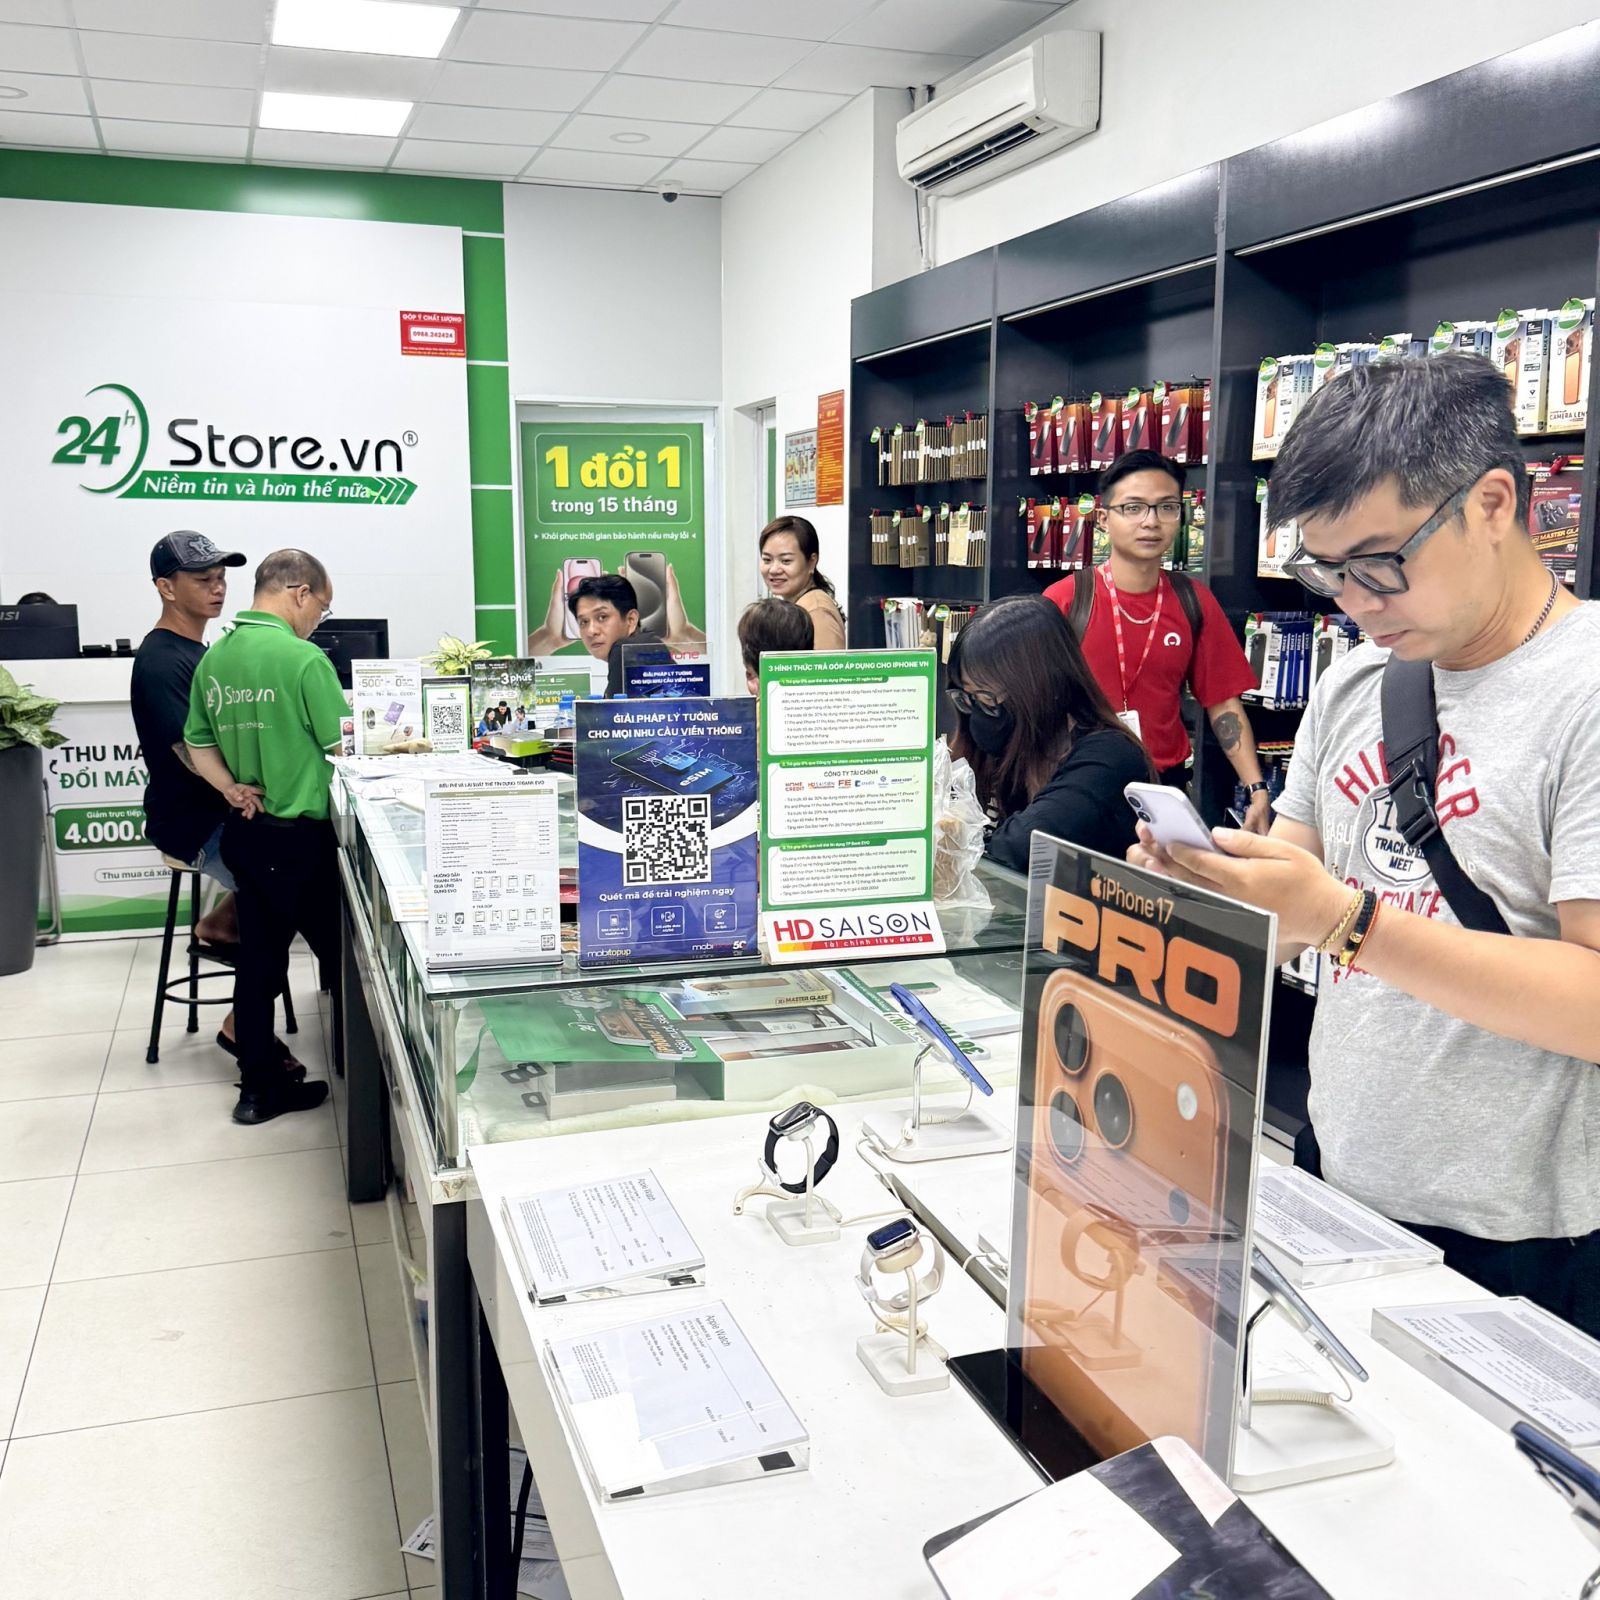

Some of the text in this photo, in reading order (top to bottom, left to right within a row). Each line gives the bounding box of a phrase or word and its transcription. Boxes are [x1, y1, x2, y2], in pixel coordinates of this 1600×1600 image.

[167, 418, 404, 473] Store.vn
[545, 444, 681, 489] 1 đổi 1
[144, 473, 370, 499] Niềm tin và hơn thế nữa
[550, 494, 678, 516] trong 15 tháng
[595, 532, 612, 541] gian
[628, 531, 645, 540] hành
[663, 531, 679, 541] máy
[1540, 527, 1579, 540] MASTER GLA
[774, 663, 793, 672] HÌNH
[793, 662, 813, 671] THỨC
[813, 661, 828, 671] TRẢ
[828, 661, 844, 670] GÓP
[844, 661, 855, 670] ÁP
[855, 662, 876, 671] DỤNG
[919, 660, 929, 668] VN
[501, 672, 510, 685] 3
[510, 672, 533, 684] phút
[587, 729, 610, 739] CHO
[611, 729, 632, 740] MỌI
[633, 728, 655, 738] NHU
[706, 725, 743, 736] THÔNG
[60, 745, 107, 763] THU
[60, 765, 151, 789] ĐỔI MÁY
[823, 770, 841, 778] CÔNG
[86, 809, 142, 819] Giảm trực tiếp
[1374, 836, 1406, 856] TRACK
[1388, 856, 1414, 873] MEET
[102, 871, 120, 880] Thu
[121, 871, 142, 879] mua
[143, 869, 155, 878] cả
[599, 892, 623, 902] Quét
[625, 891, 640, 900] mã
[642, 890, 655, 899] để
[674, 888, 710, 898] nghiệm
[712, 887, 736, 896] ngay
[1102, 877, 1175, 925] iPhone 17
[773, 911, 931, 942] HD SAISON
[824, 935, 924, 949] Tài chính tiêu dùng
[1043, 883, 1241, 1038] PRO
[713, 1327, 732, 1349] Watch
